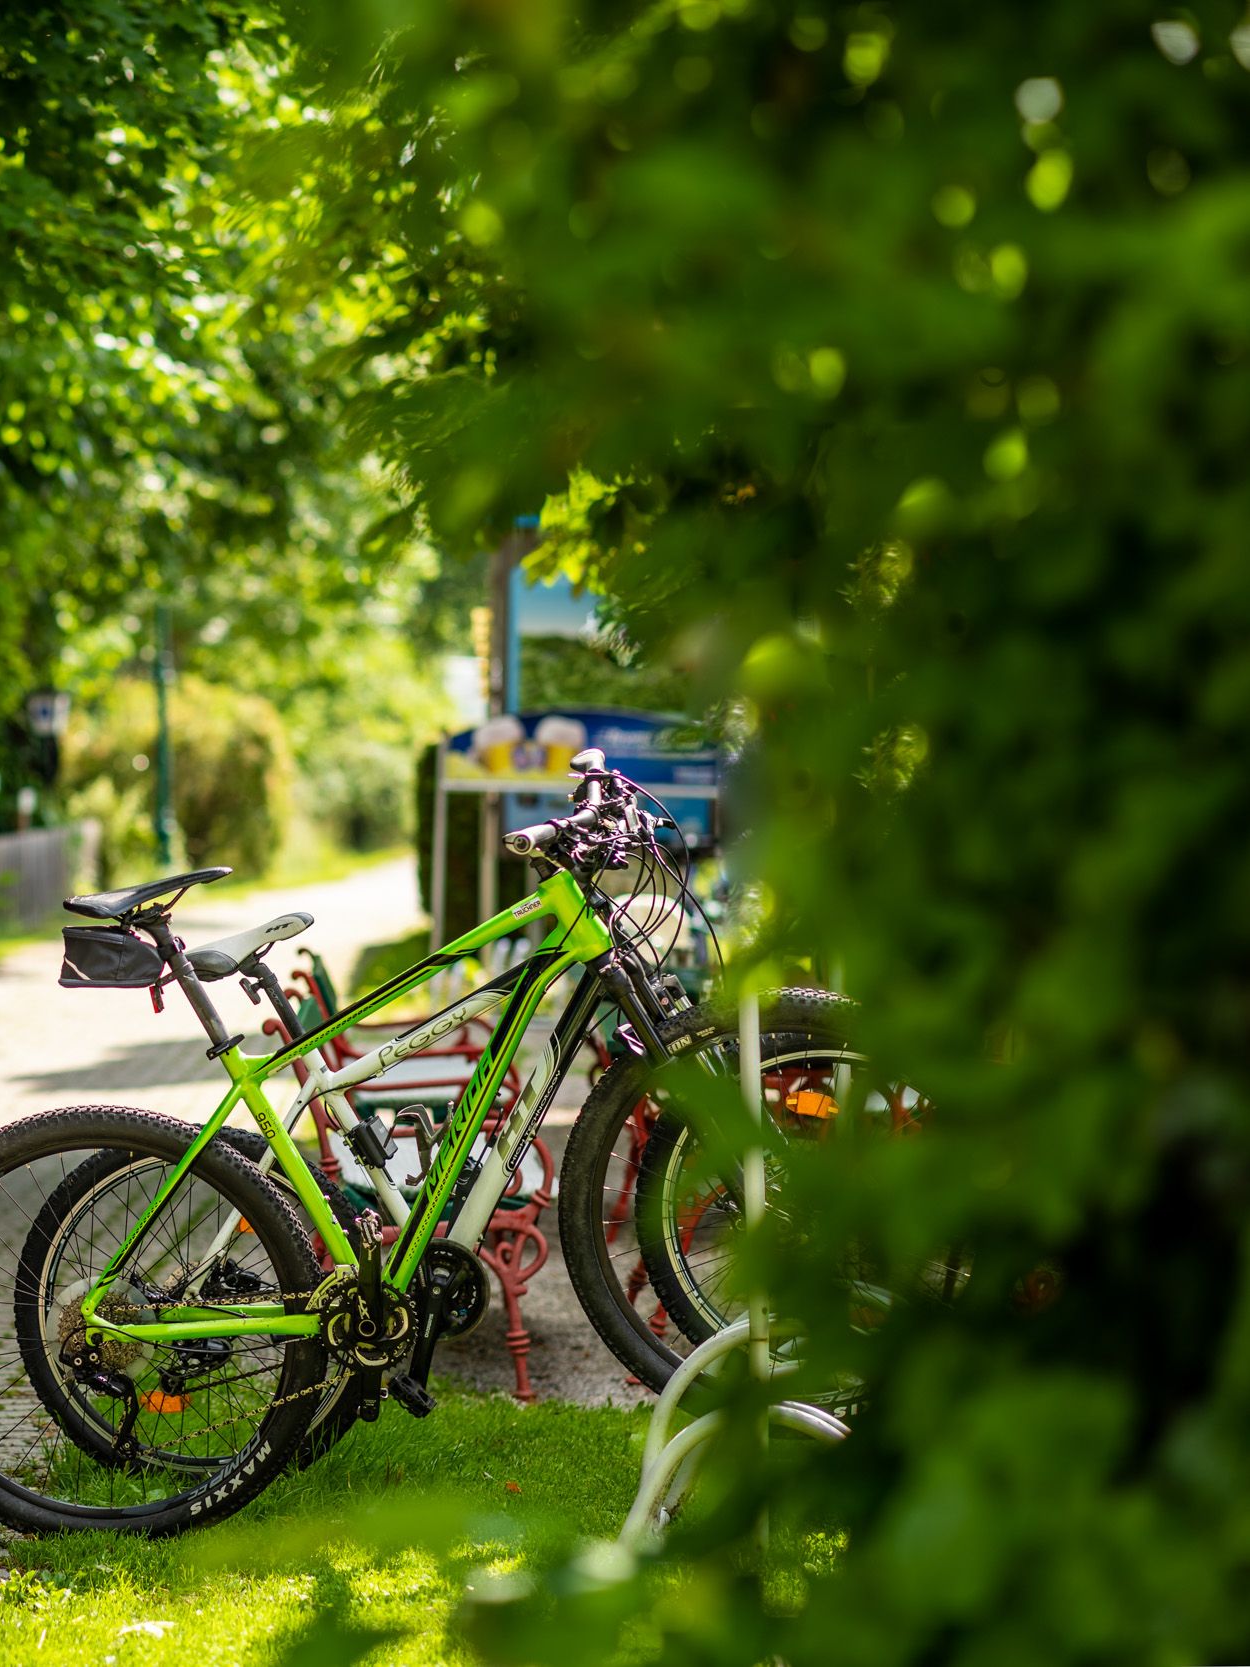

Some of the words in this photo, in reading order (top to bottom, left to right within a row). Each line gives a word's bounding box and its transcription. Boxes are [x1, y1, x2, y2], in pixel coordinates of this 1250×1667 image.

[378, 1007, 466, 1067] PEGGY
[255, 1112, 276, 1139] 950
[424, 1050, 495, 1202] MERIDA
[509, 1138, 529, 1166] HIGH
[525, 1069, 561, 1138] TECHNOLOGY
[190, 1440, 271, 1515] MAXXIS
[208, 1430, 261, 1489] COMP
